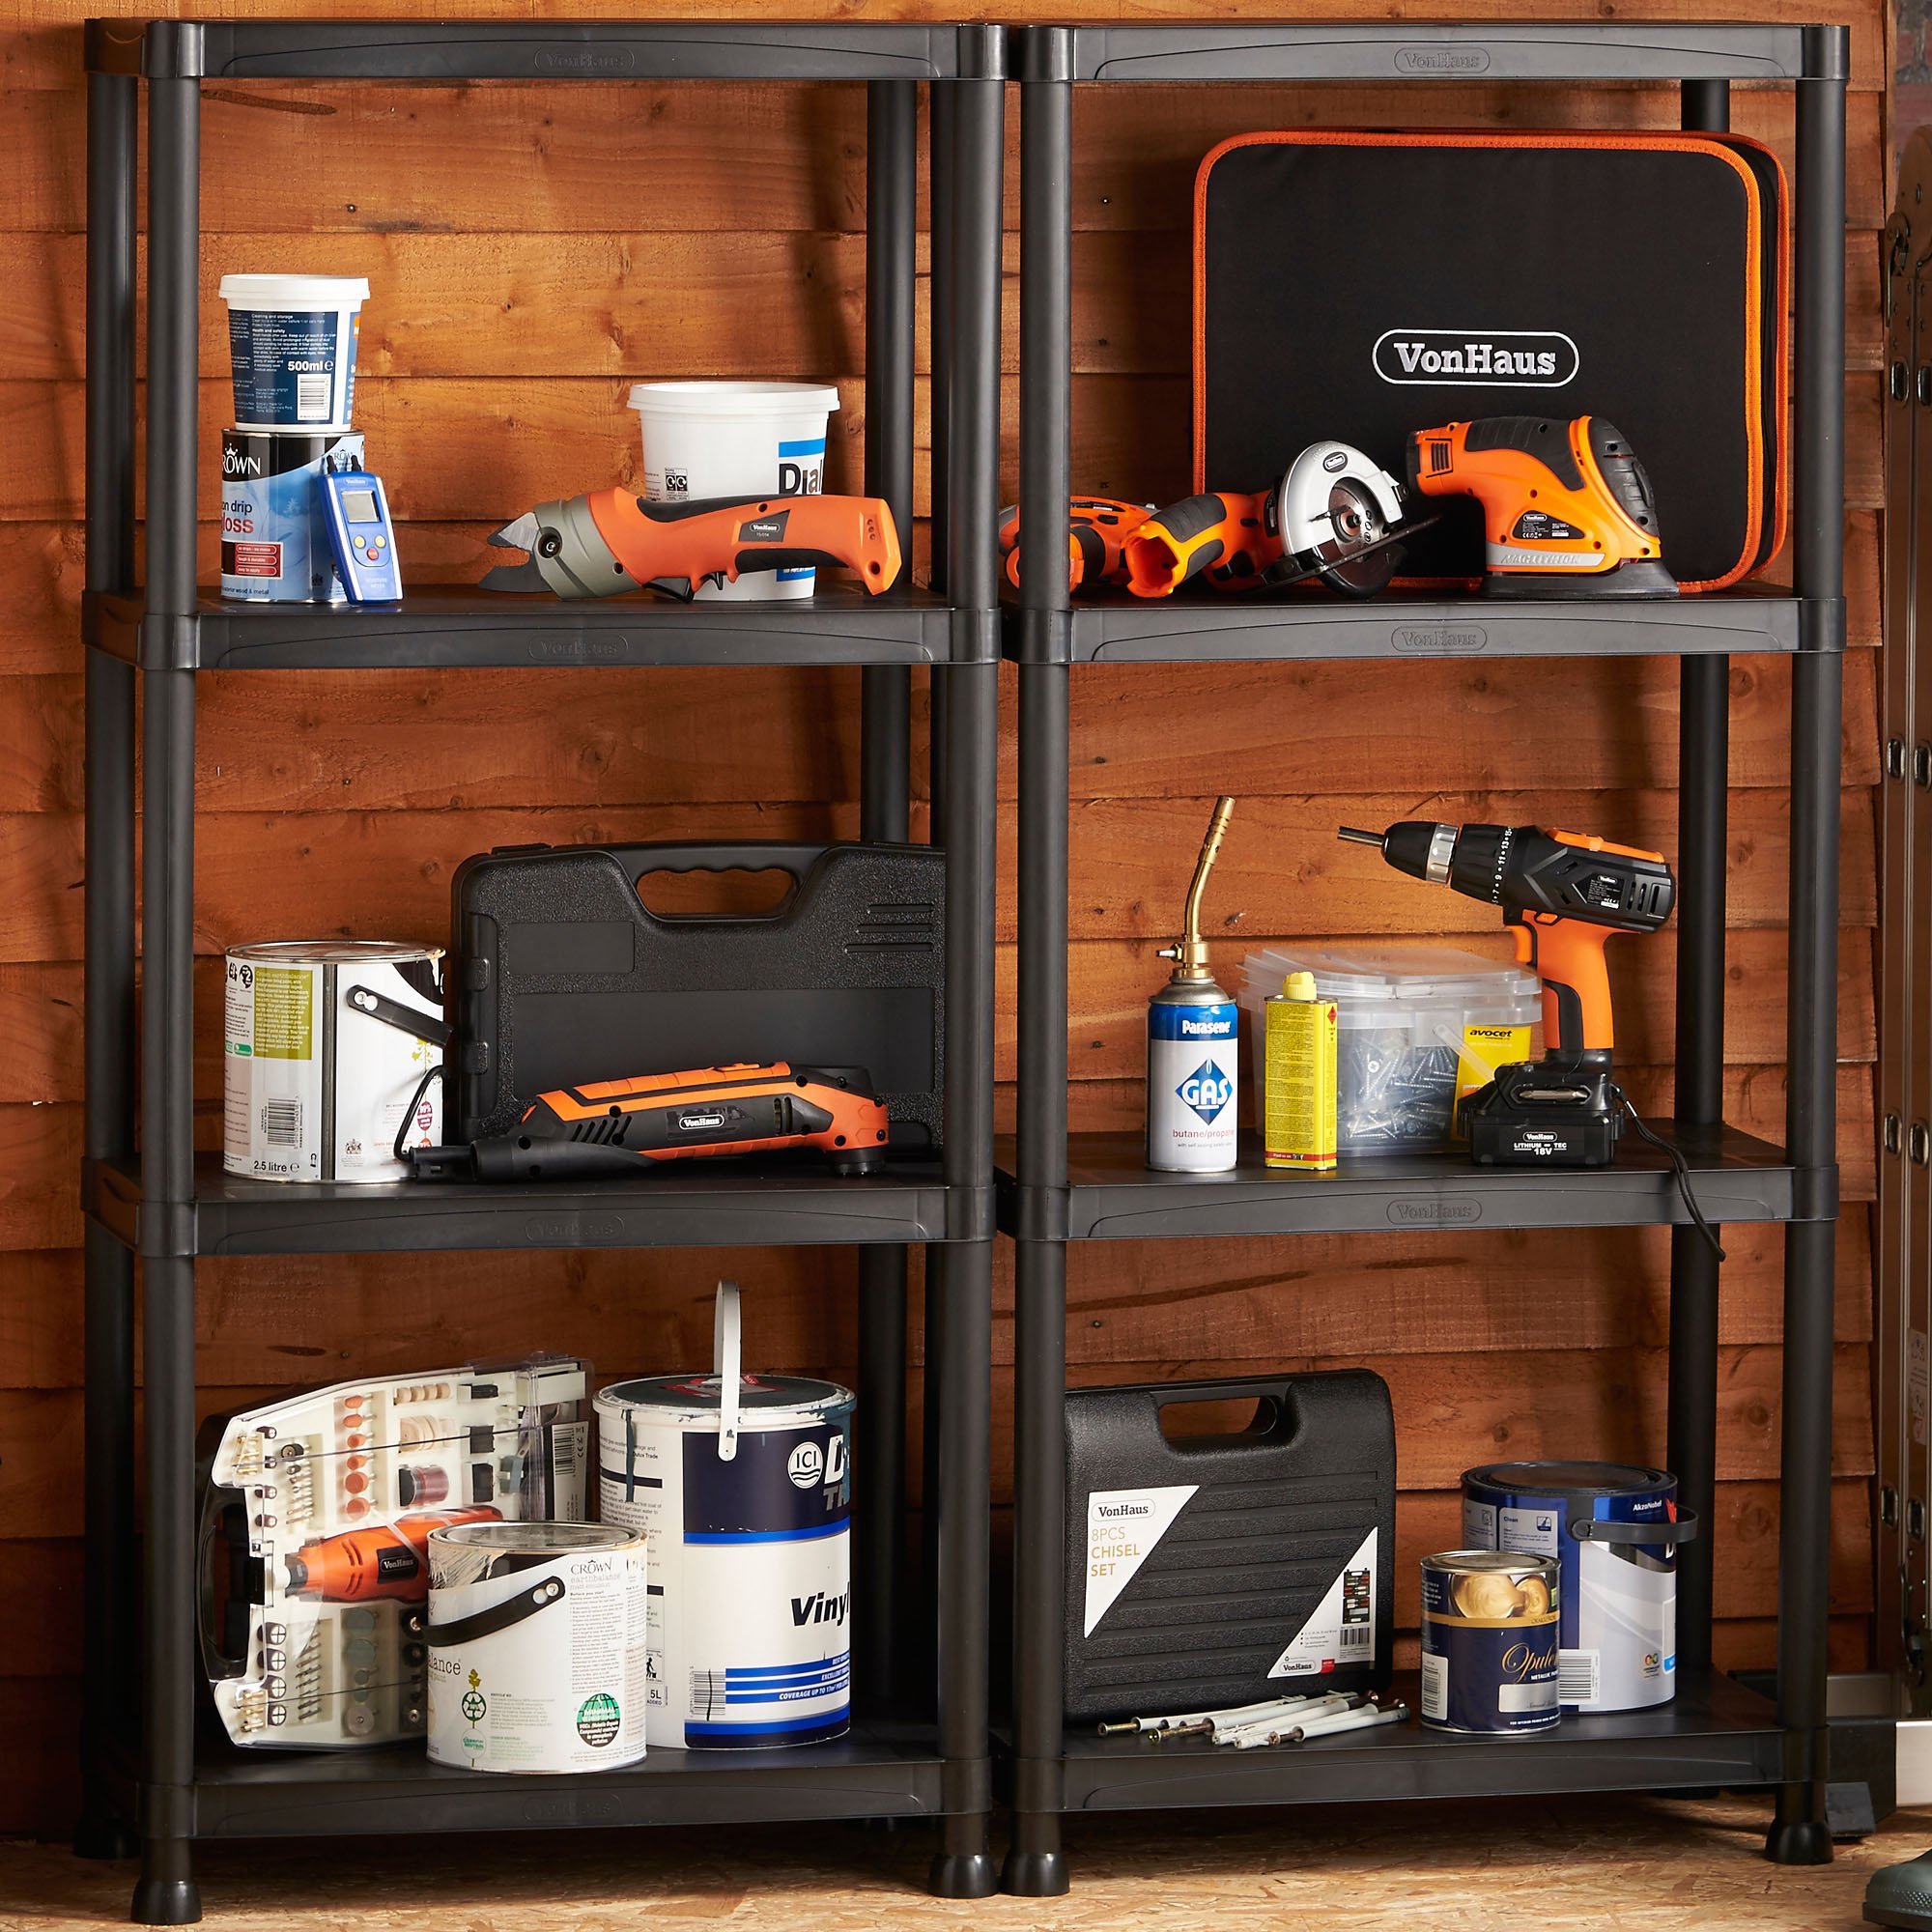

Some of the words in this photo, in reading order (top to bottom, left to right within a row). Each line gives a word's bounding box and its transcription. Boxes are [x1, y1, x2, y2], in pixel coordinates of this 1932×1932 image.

[1405, 52, 1480, 69] VonHaus
[1394, 342, 1556, 375] VonHaus
[287, 361, 323, 371] 500ml
[223, 456, 261, 475] ROWN
[231, 501, 253, 515] drip
[1401, 631, 1477, 647] VonHaus
[1501, 841, 1509, 850] 13
[1498, 856, 1506, 865] 11
[1182, 1020, 1231, 1035] Parasene
[1181, 1078, 1229, 1106] GAS
[683, 1118, 720, 1127] VonHaus
[254, 1160, 267, 1171] 2.5
[269, 1162, 287, 1172] litre
[1397, 1204, 1472, 1219] VonHaus
[796, 1450, 817, 1469] ICI
[1098, 1505, 1149, 1517] VonHaus
[1633, 1500, 1662, 1511] AkzoNobel
[1091, 1527, 1125, 1542] 8PCS
[1091, 1544, 1140, 1559] CHISEL
[383, 1560, 414, 1569] VonHaus
[570, 1557, 612, 1575] CROWN
[1091, 1563, 1116, 1577] SET
[791, 1581, 850, 1626] Vinyl
[1283, 1662, 1313, 1671] VonHaus
[650, 1689, 662, 1699] 5L
[779, 1690, 810, 1700] COVERAGE
